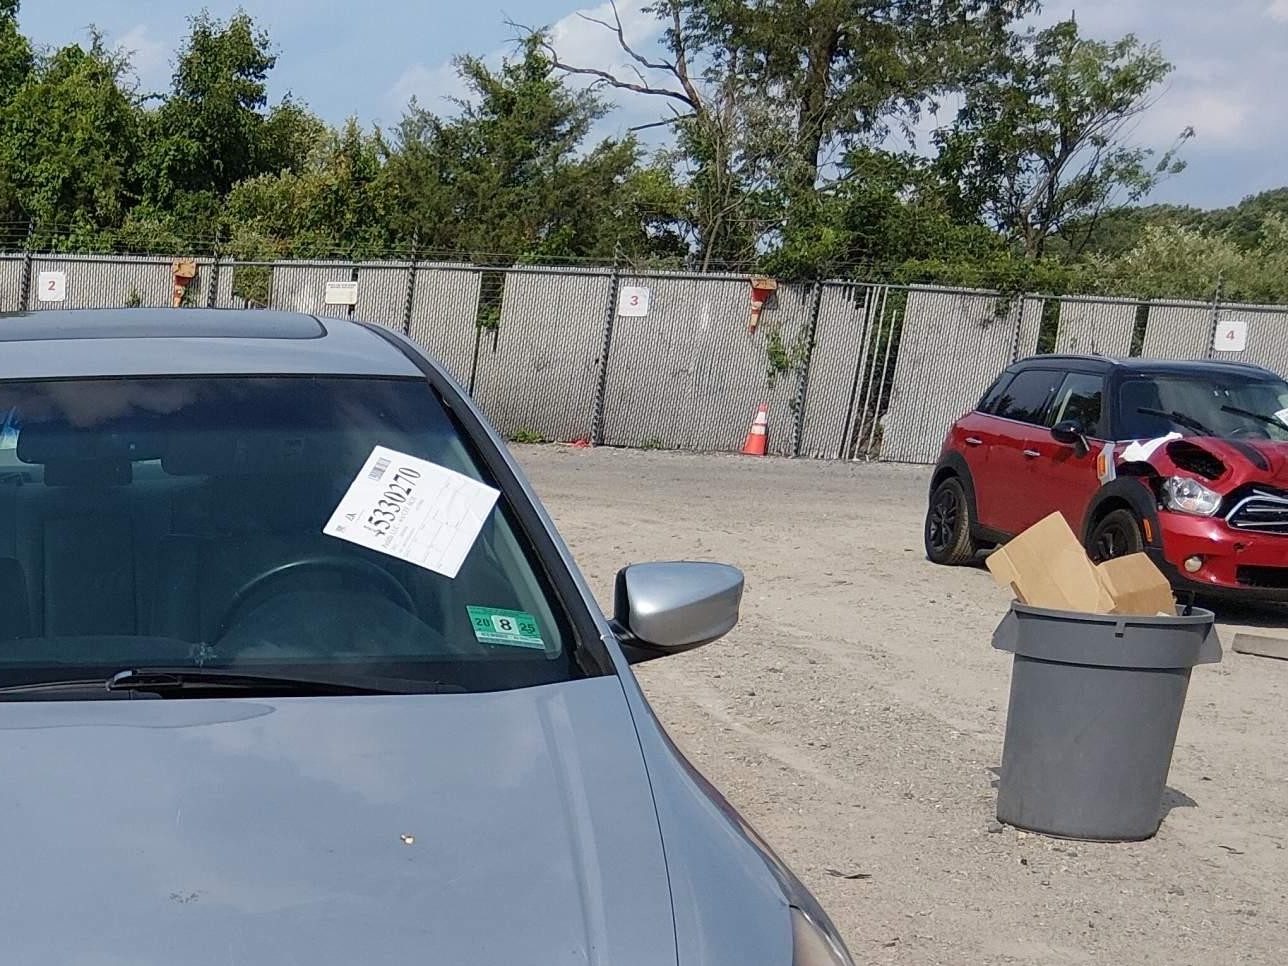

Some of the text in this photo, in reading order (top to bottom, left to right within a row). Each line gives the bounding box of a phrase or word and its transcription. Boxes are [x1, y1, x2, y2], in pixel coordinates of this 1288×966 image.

[47, 280, 57, 291] 2
[630, 295, 639, 306] 3
[1225, 329, 1235, 340] 4
[474, 617, 536, 634] 20 8 25
